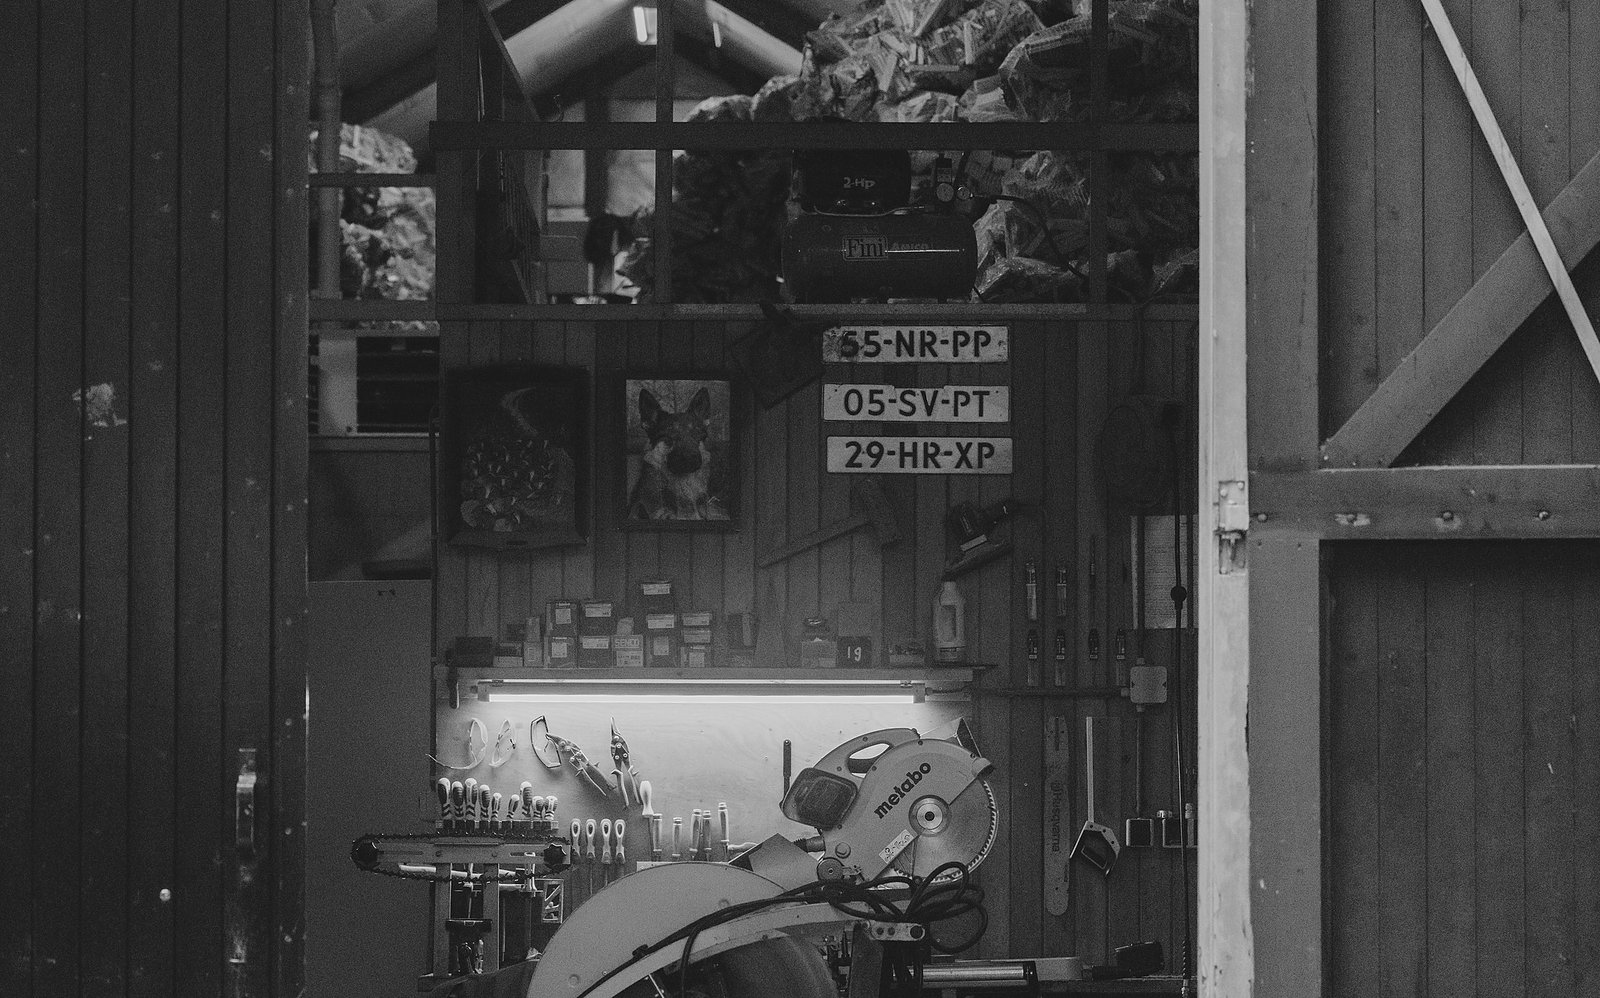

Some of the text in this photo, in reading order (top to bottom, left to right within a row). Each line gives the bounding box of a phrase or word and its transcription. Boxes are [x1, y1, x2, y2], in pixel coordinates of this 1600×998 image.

[847, 238, 884, 257] Fini
[844, 389, 990, 416] 05-SV-PT
[845, 441, 994, 469] 29-HR-XP
[873, 763, 932, 819] metabo
[1051, 792, 1062, 852] Husqvarna
